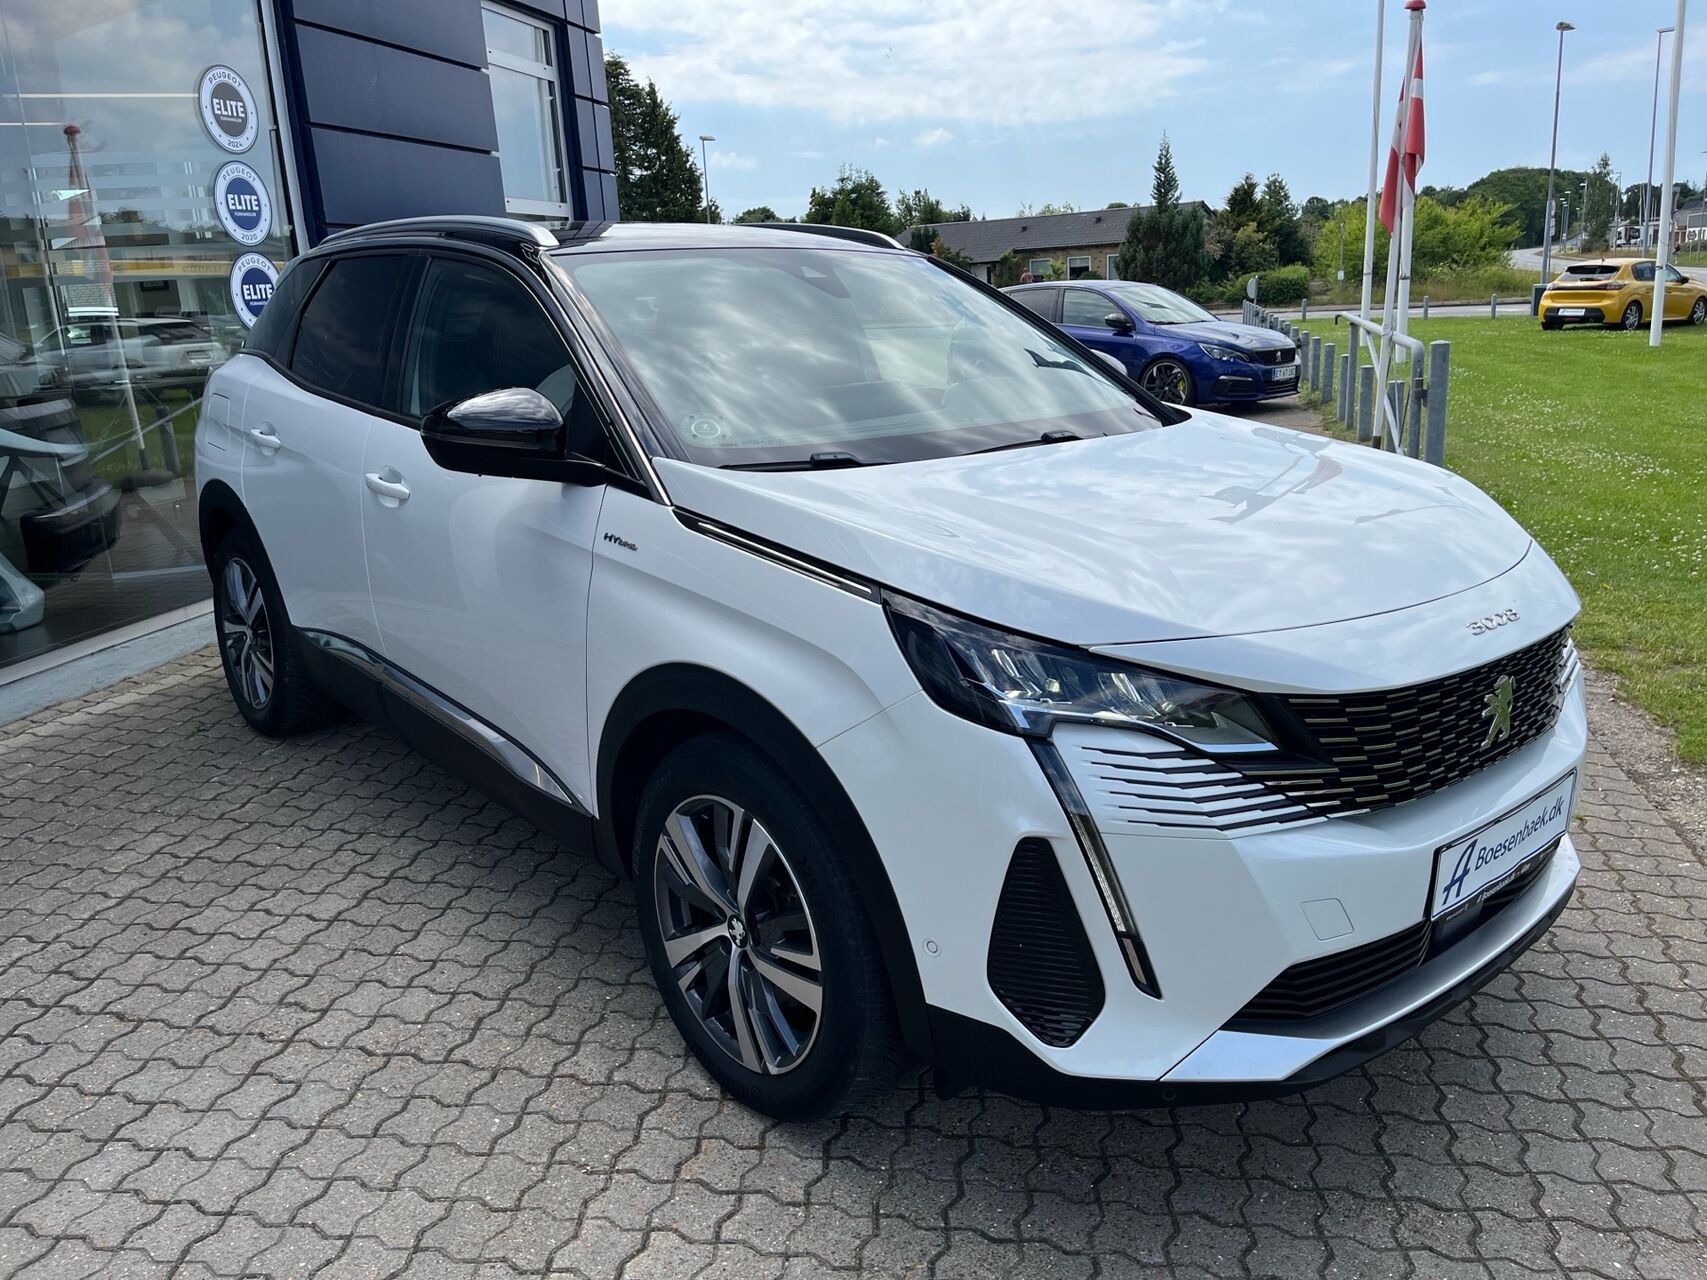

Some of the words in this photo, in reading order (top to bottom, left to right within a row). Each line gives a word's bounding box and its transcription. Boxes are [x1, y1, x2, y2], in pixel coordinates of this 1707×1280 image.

[208, 71, 242, 88] PEUGEOT
[212, 98, 245, 117] ELITE
[227, 139, 243, 148] 2024
[222, 167, 256, 182] PEUGEOT
[227, 193, 259, 211] ELITE
[241, 233, 258, 241] 2020
[238, 257, 271, 272] PEUGEOT
[242, 284, 273, 300] ELITE
[1466, 608, 1520, 636] 3008
[1475, 796, 1565, 871] Boesenbaek.dk
